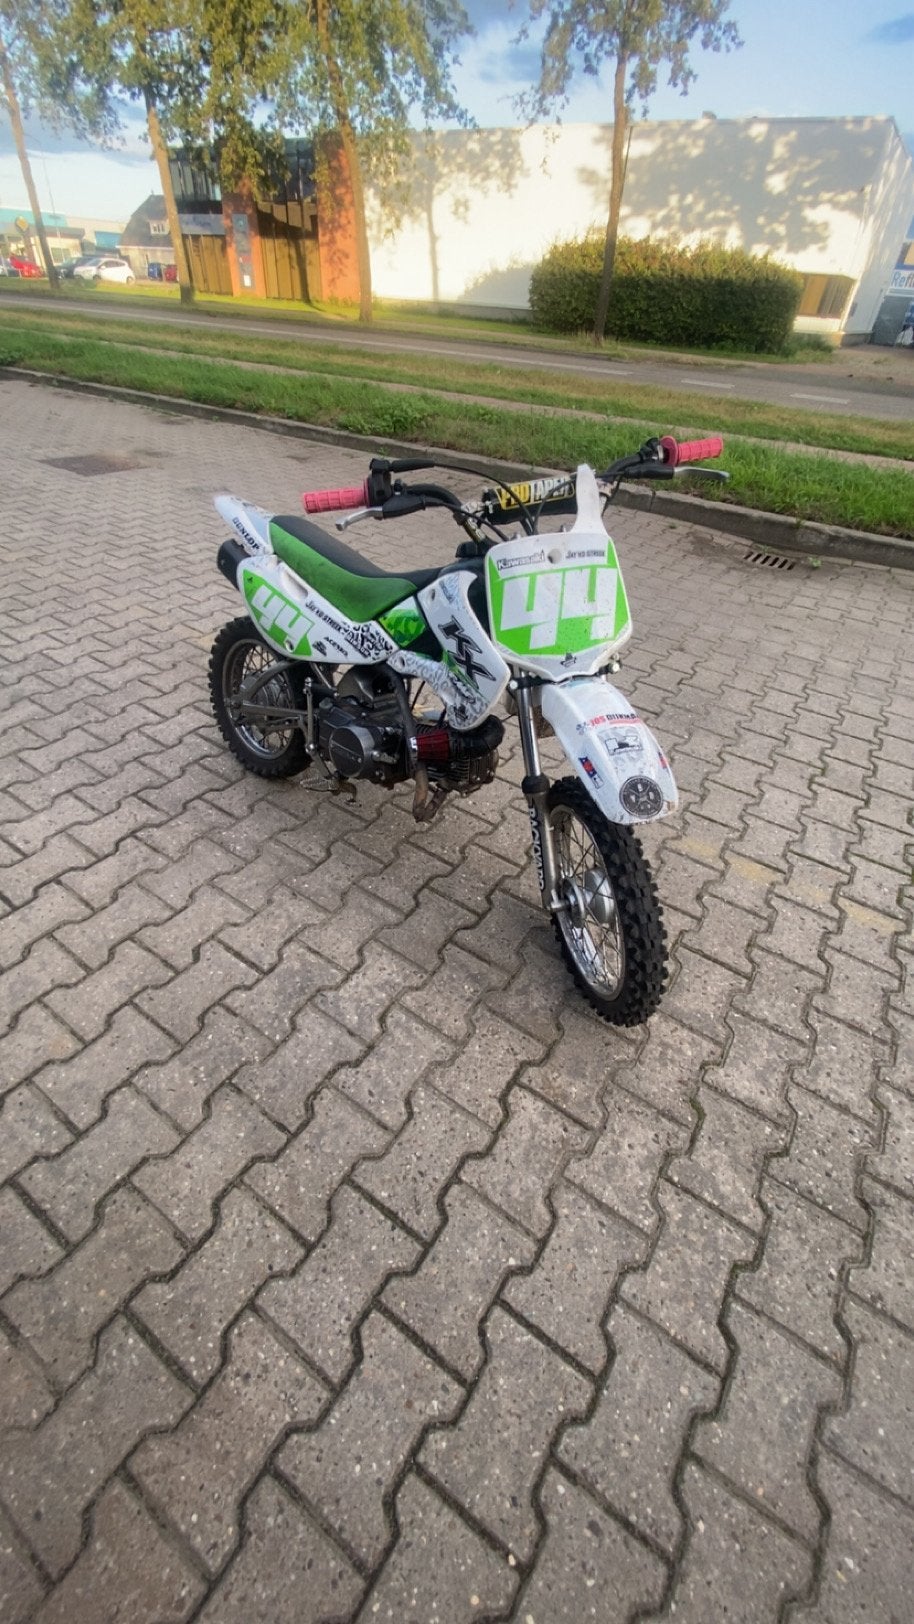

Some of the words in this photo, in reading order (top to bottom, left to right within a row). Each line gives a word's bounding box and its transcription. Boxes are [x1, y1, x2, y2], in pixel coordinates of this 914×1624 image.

[232, 516, 260, 550] DUNLOP
[497, 549, 546, 571] Kawasaki
[251, 584, 315, 651] 44
[501, 567, 618, 650] 44
[438, 614, 497, 690] KX
